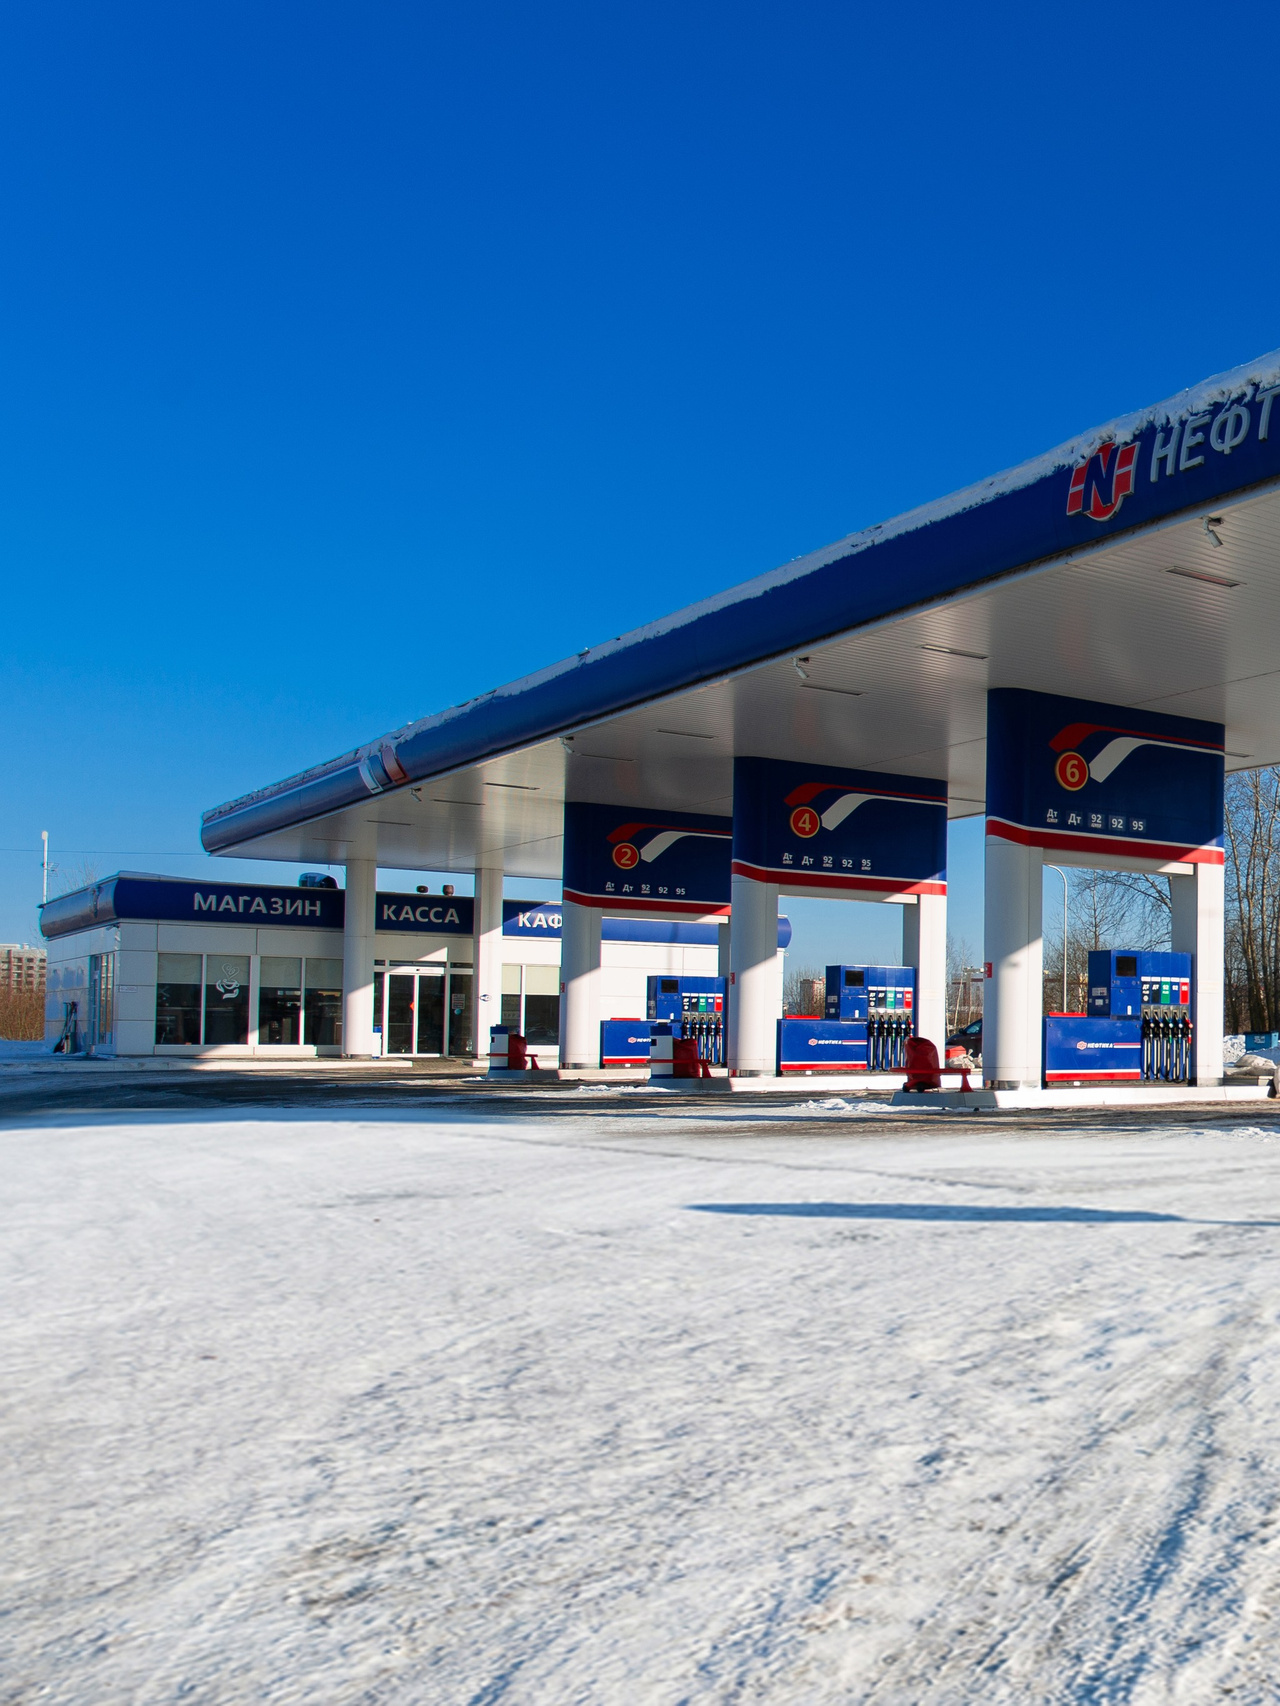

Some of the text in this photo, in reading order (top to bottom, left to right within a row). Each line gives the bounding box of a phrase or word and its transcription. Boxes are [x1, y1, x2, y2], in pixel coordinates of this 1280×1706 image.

[1066, 760, 1080, 783] 6
[798, 813, 811, 832] 4
[1047, 809, 1058, 819] Дт
[1068, 813, 1081, 825] Дт
[1091, 814, 1102, 823] 92
[1111, 819, 1123, 828] 92
[1132, 821, 1143, 830] 95
[620, 848, 632, 864] 2
[801, 856, 814, 866] Дт
[842, 859, 853, 868] 92
[861, 859, 871, 867] 95
[622, 884, 634, 892] Дт
[658, 886, 668, 894] 92
[676, 887, 686, 895] 95
[193, 892, 321, 917] МАГАЗИН
[383, 904, 460, 924] КАССА
[518, 912, 563, 929] КАФ
